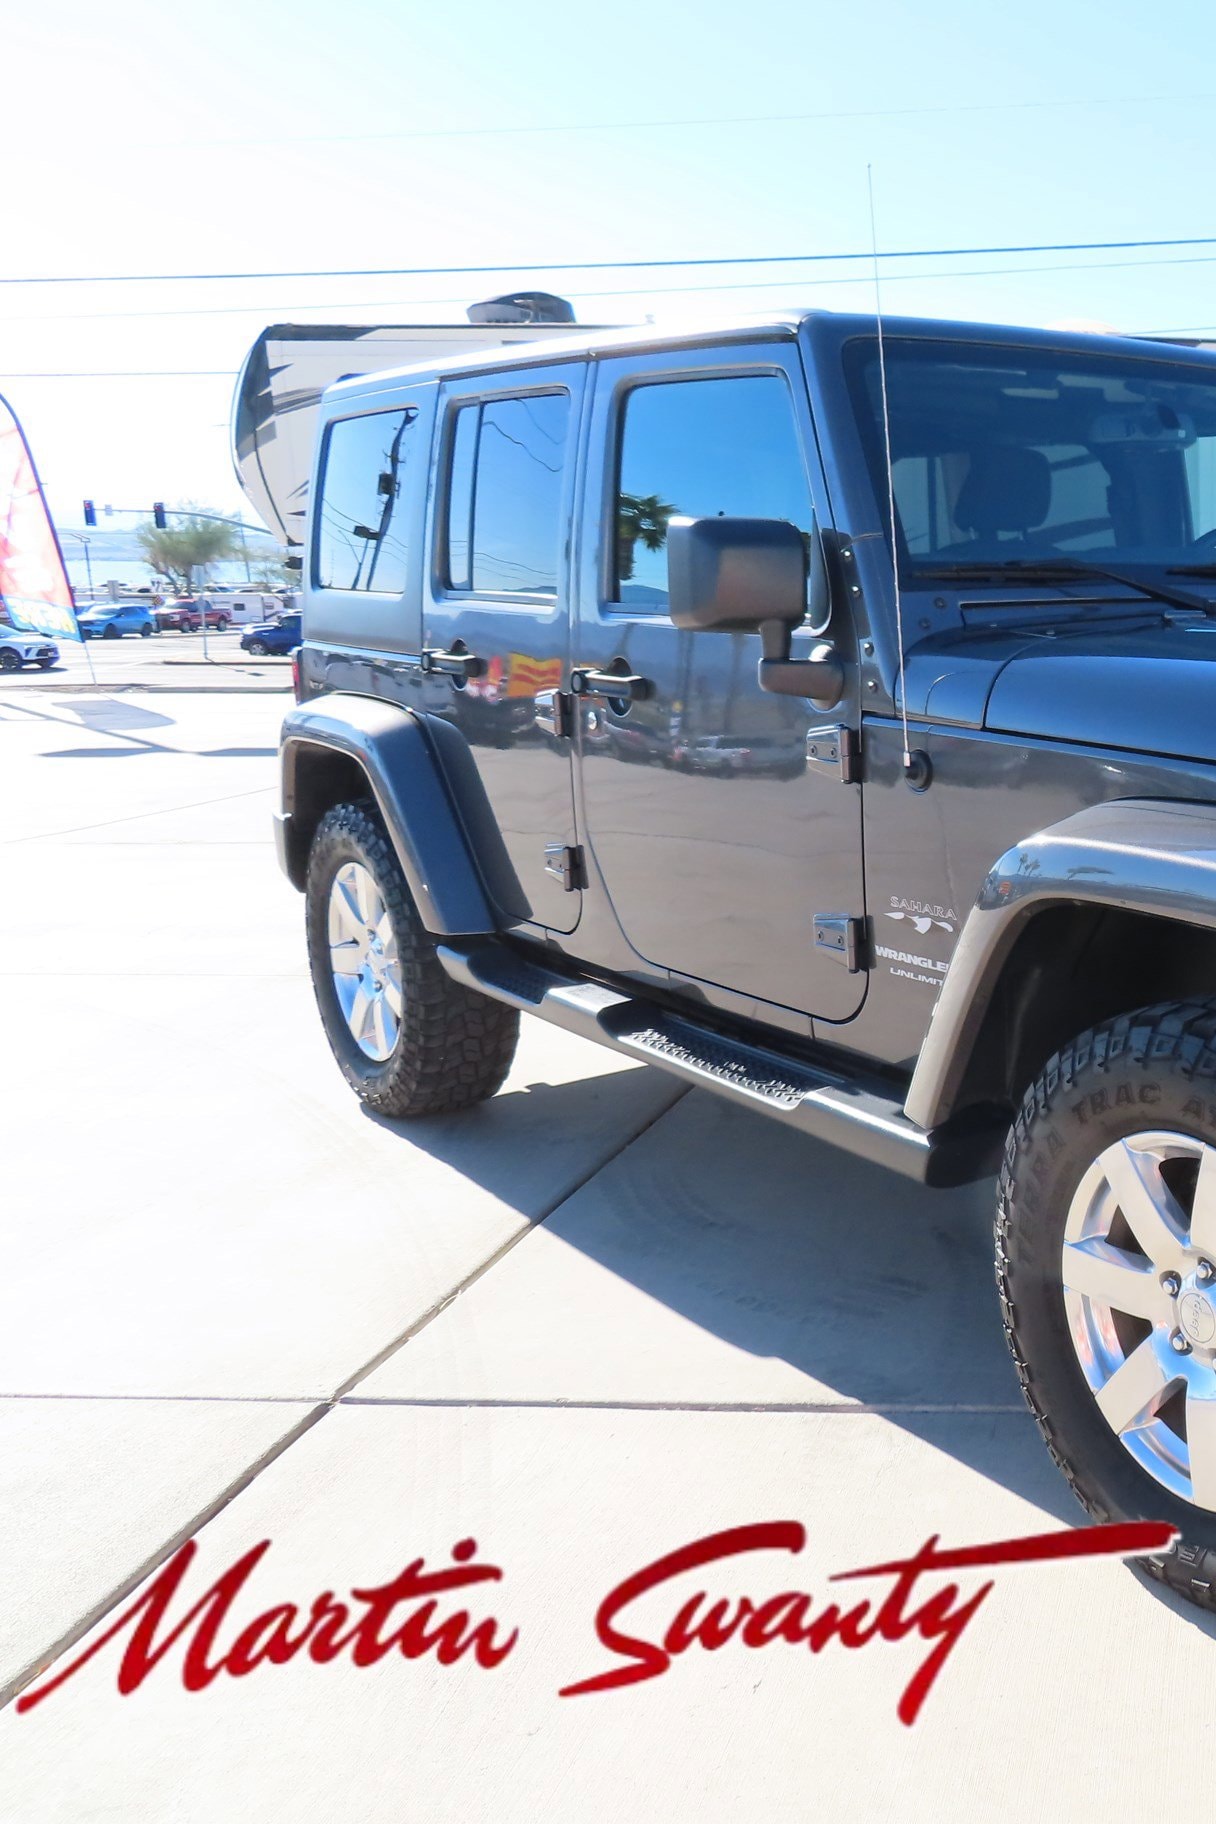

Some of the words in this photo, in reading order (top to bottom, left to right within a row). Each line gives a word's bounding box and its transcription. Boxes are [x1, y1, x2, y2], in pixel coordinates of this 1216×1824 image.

[889, 896, 957, 921] SAHARA
[889, 967, 945, 987] UNLIMIT
[1072, 1081, 1162, 1126] TRAC
